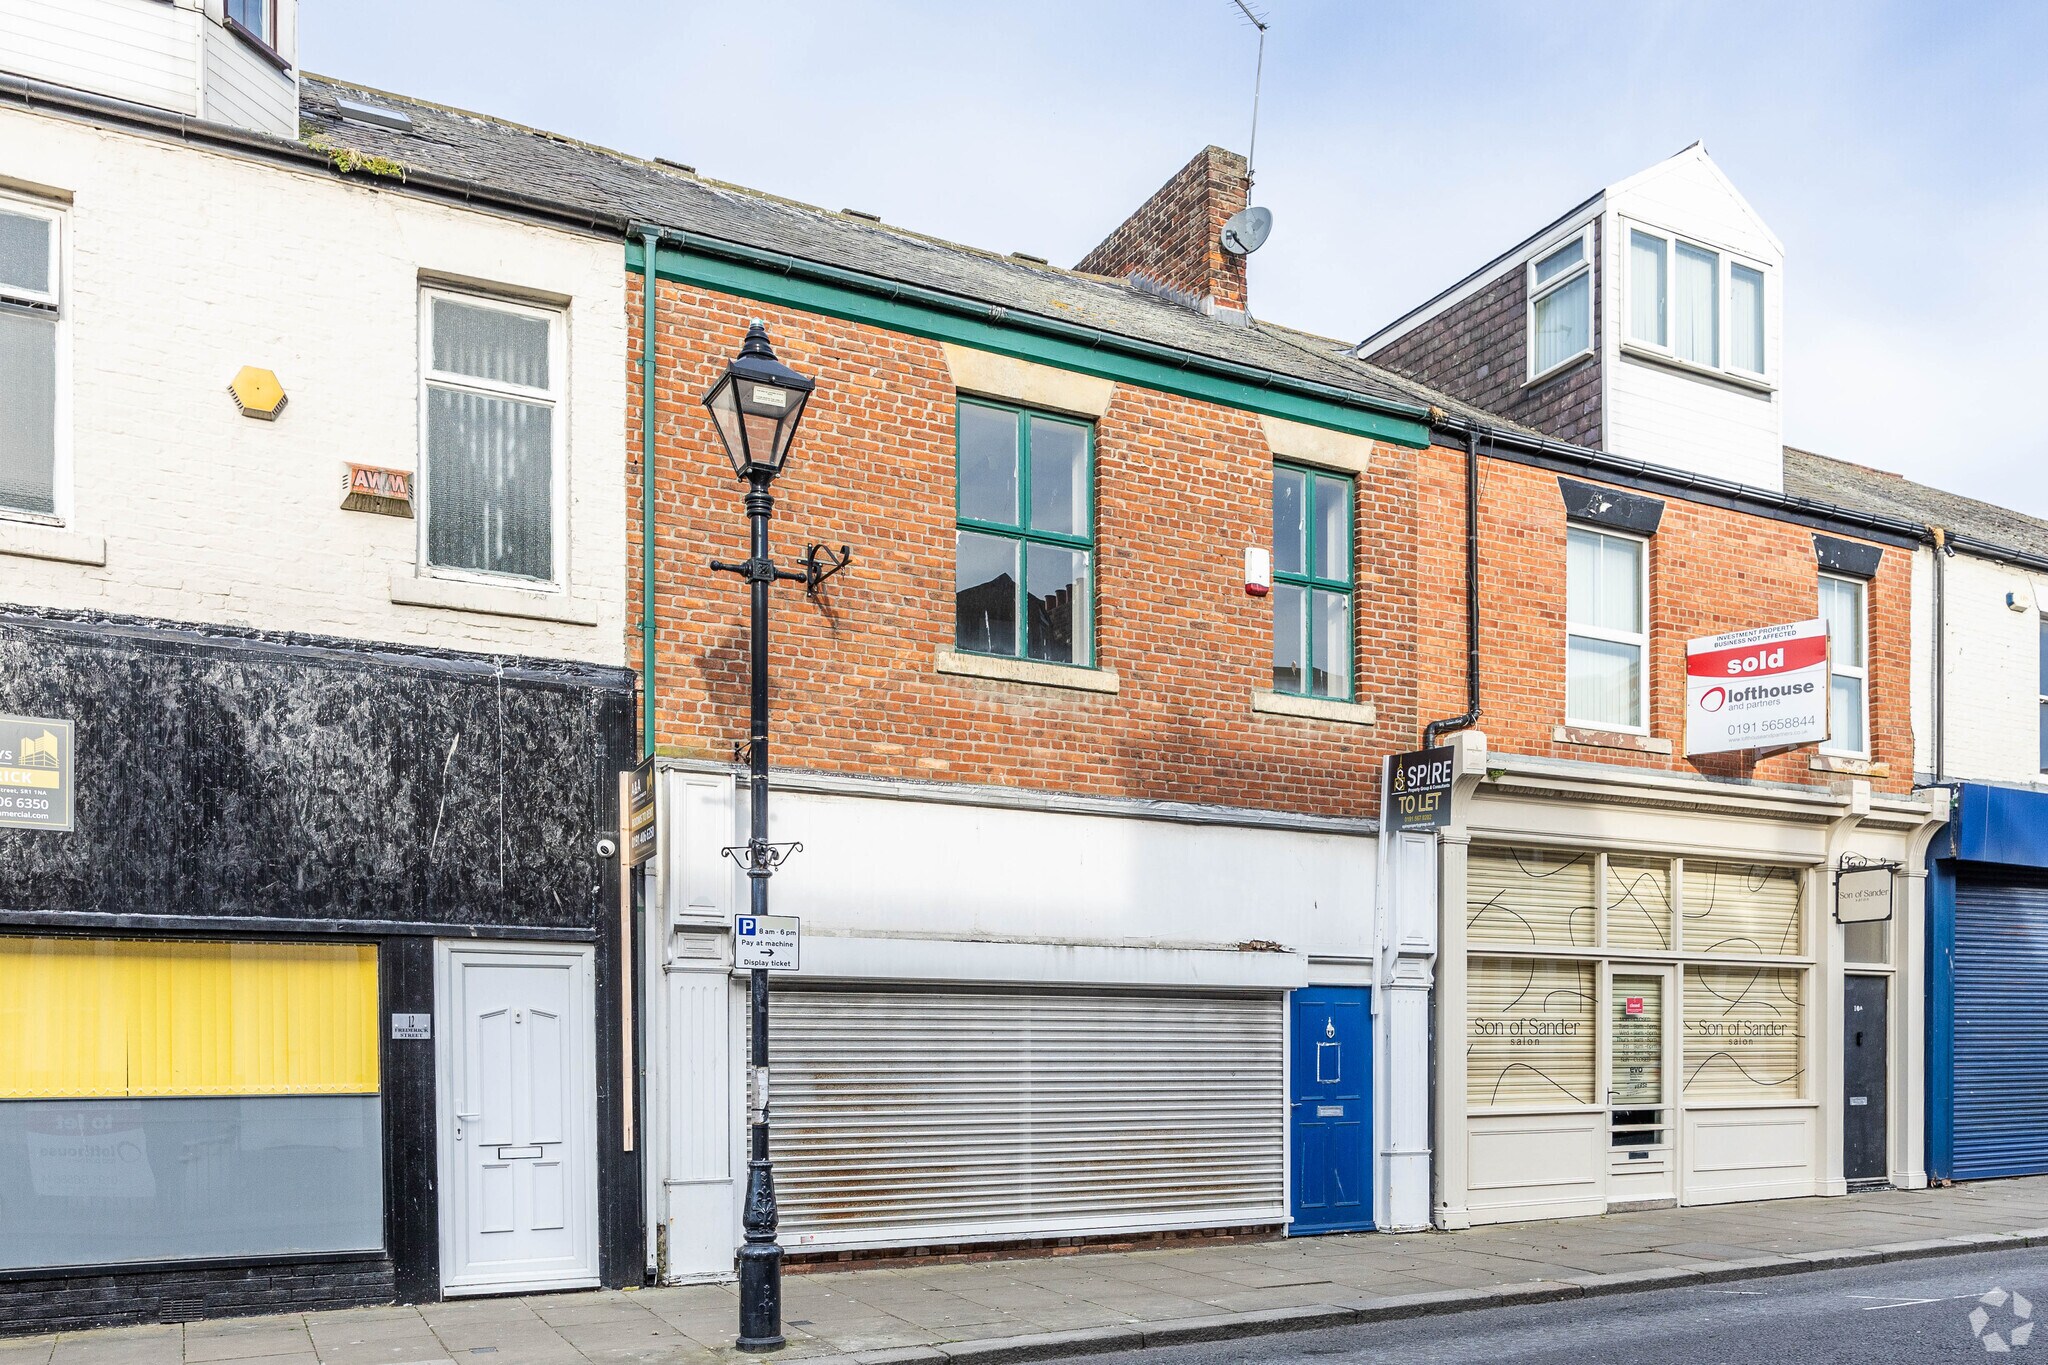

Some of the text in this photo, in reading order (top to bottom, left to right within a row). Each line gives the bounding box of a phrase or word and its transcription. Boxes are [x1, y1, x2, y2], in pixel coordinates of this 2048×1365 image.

[353, 469, 406, 493] AWM
[1714, 630, 1797, 648] BUSINESS NOT AFFECTED
[1717, 624, 1794, 641] INVESTMENT PROPERTY
[1727, 648, 1784, 674] sold
[1728, 682, 1814, 703] lofthouse
[1728, 698, 1781, 711] and partners
[1728, 715, 1815, 735] 0191 5658844
[0, 771, 32, 784] ICK
[1407, 759, 1452, 787] SPIRE
[16, 797, 49, 810] 6350
[1398, 792, 1442, 815] TO LET
[1839, 889, 1889, 899] Son of Sander
[742, 919, 754, 934] P
[741, 939, 754, 947] Pay
[765, 940, 794, 948] machine
[743, 959, 770, 967] Display
[408, 1015, 415, 1028] 12
[1474, 1017, 1581, 1036] Son of Sander
[1698, 1019, 1788, 1036] Son of Sander
[1510, 1037, 1540, 1046] salon
